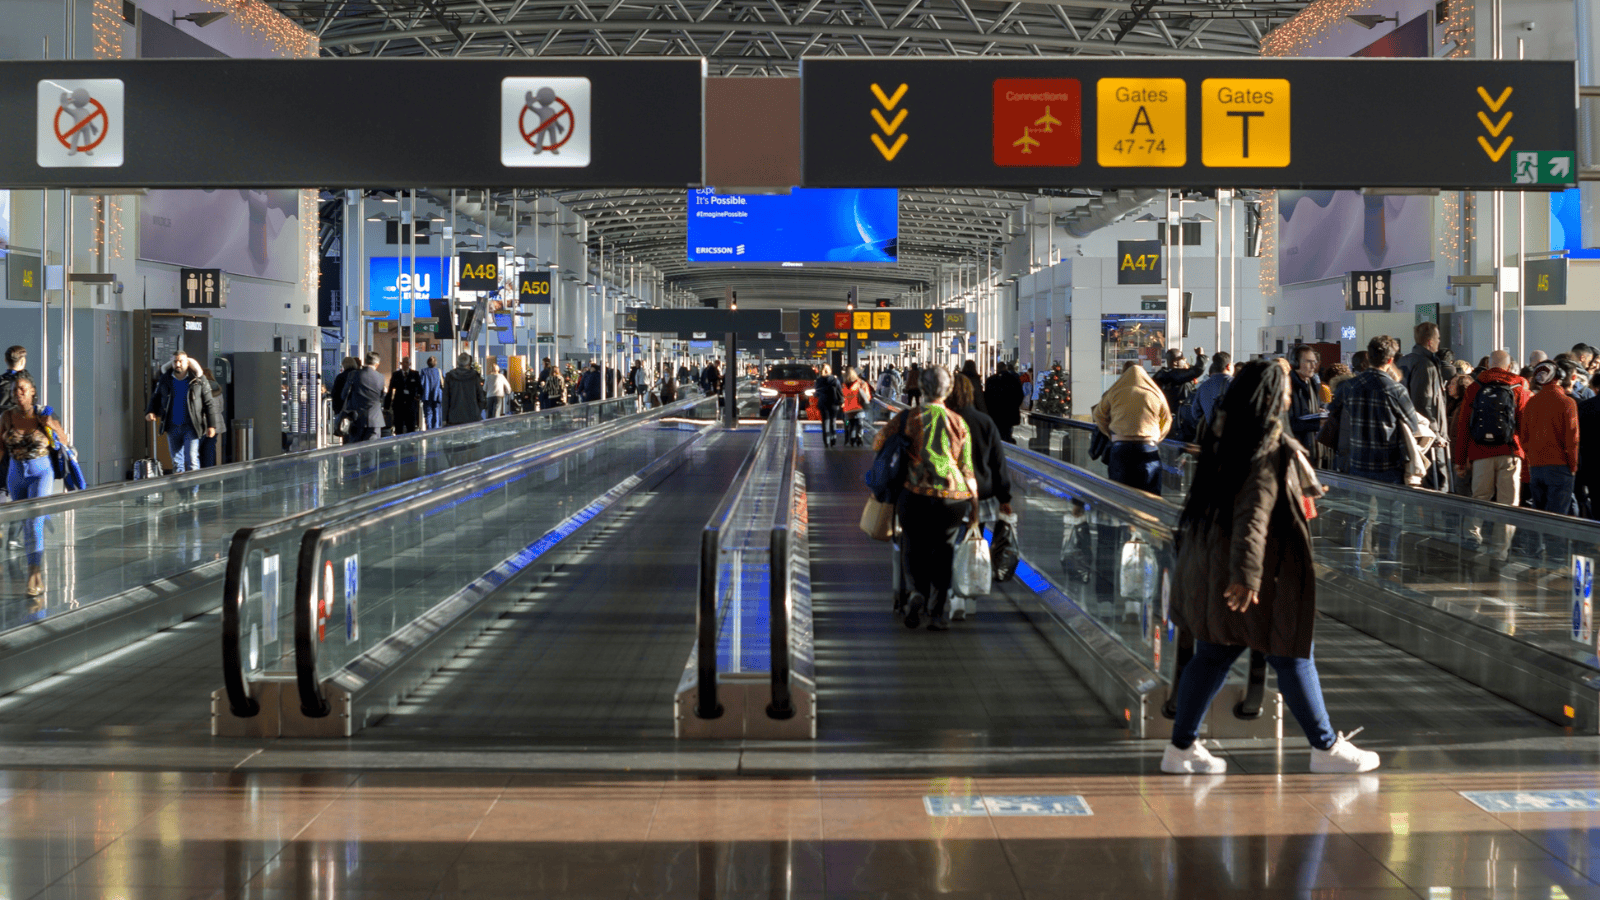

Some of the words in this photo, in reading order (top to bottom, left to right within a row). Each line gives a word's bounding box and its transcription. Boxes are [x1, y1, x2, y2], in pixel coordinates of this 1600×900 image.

[1006, 91, 1068, 101] Connections
[1116, 86, 1168, 103] Gates
[1217, 86, 1274, 104] Gates
[1130, 105, 1154, 134] A
[1226, 111, 1265, 159] T
[1113, 139, 1166, 154] 47-74
[696, 196, 709, 205] It's
[711, 196, 748, 205] Possible.
[1120, 253, 1159, 271] A47
[461, 263, 497, 280] A48
[520, 281, 550, 295] A50
